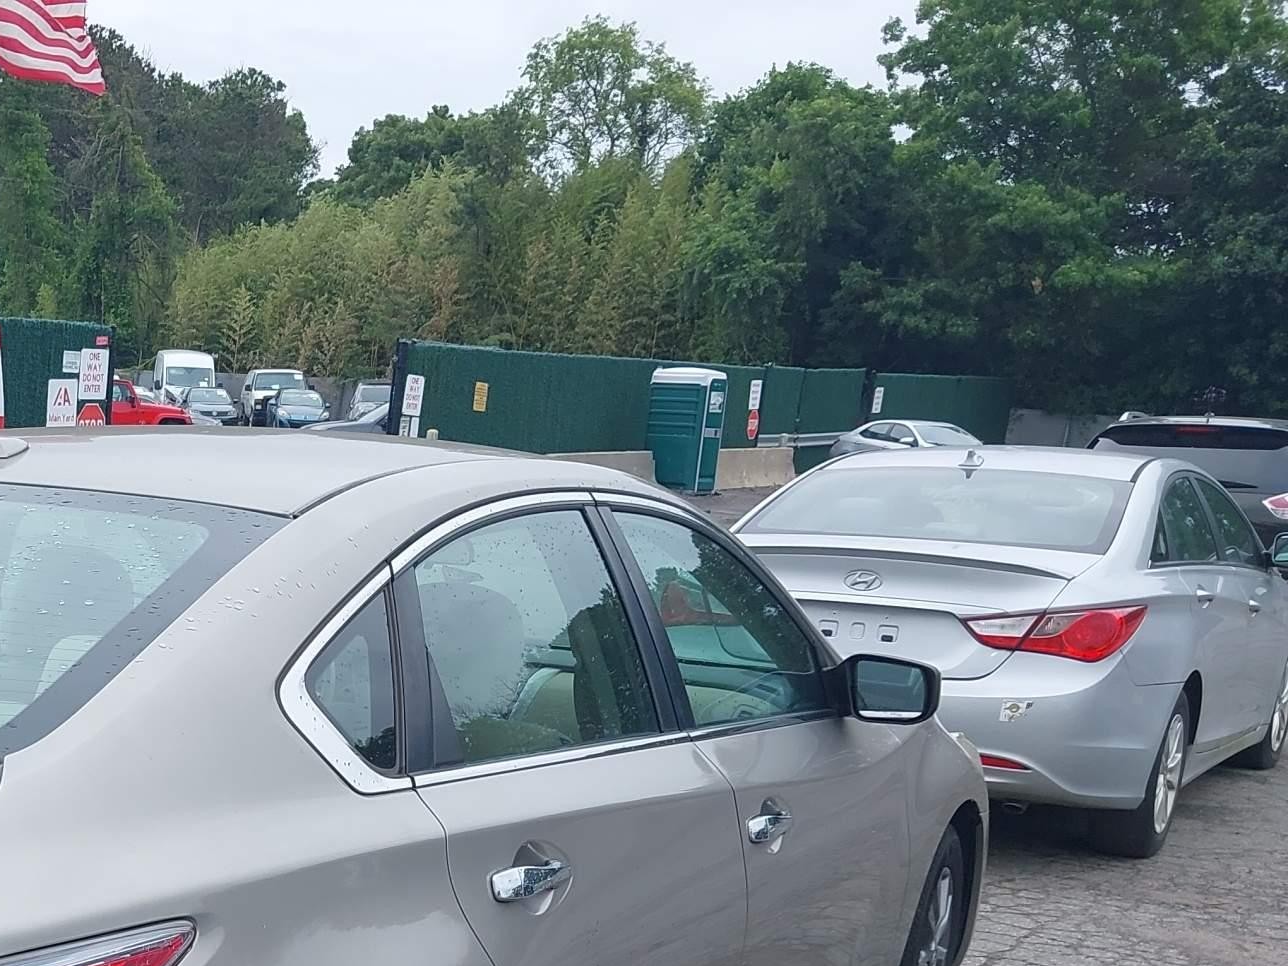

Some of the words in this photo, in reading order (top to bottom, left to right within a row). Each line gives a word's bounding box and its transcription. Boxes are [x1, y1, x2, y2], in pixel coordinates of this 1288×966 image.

[89, 352, 102, 361] ONE
[87, 363, 103, 372] WAY
[82, 373, 92, 383] DO
[92, 373, 105, 383] NOT
[84, 384, 101, 394] ENTER
[48, 413, 61, 423] Main
[62, 413, 75, 423] Yard
